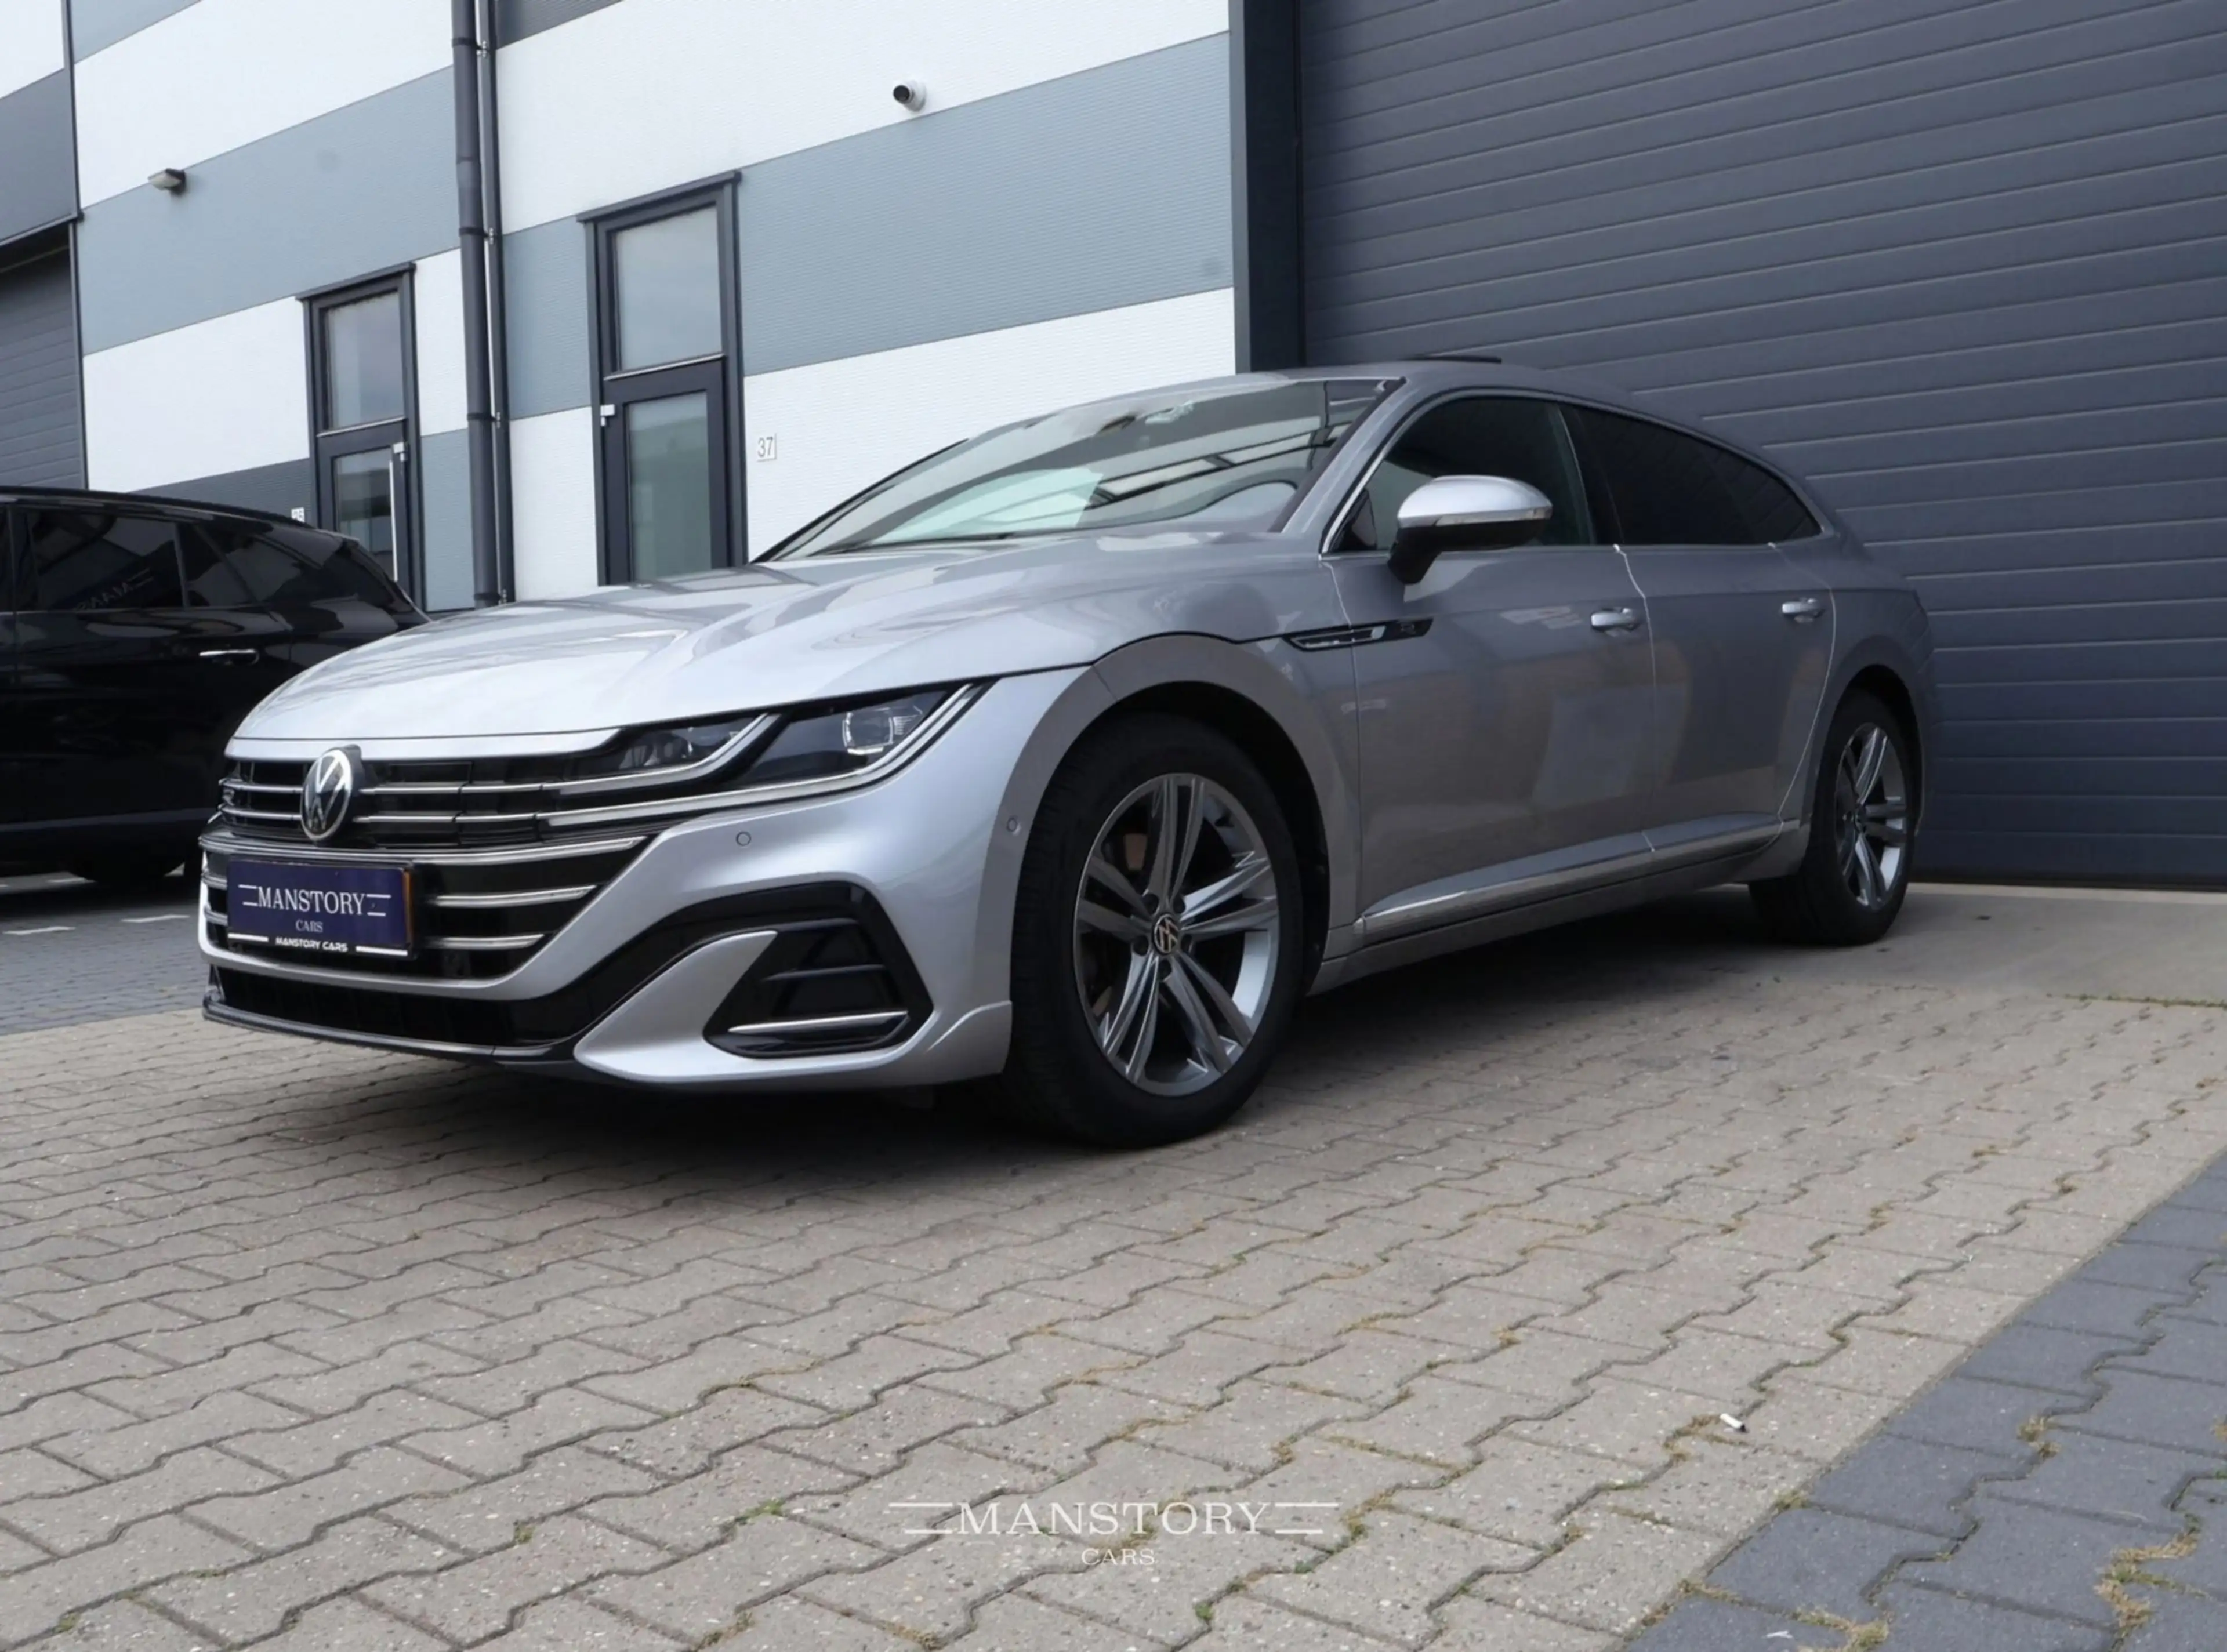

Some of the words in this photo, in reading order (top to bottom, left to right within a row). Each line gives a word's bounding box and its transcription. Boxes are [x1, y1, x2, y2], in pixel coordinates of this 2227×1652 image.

[757, 436, 774, 458] 37
[258, 886, 365, 916] MANSTORY
[295, 919, 324, 933] CARS
[275, 936, 321, 950] MANSTORY
[322, 941, 348, 952] CARS
